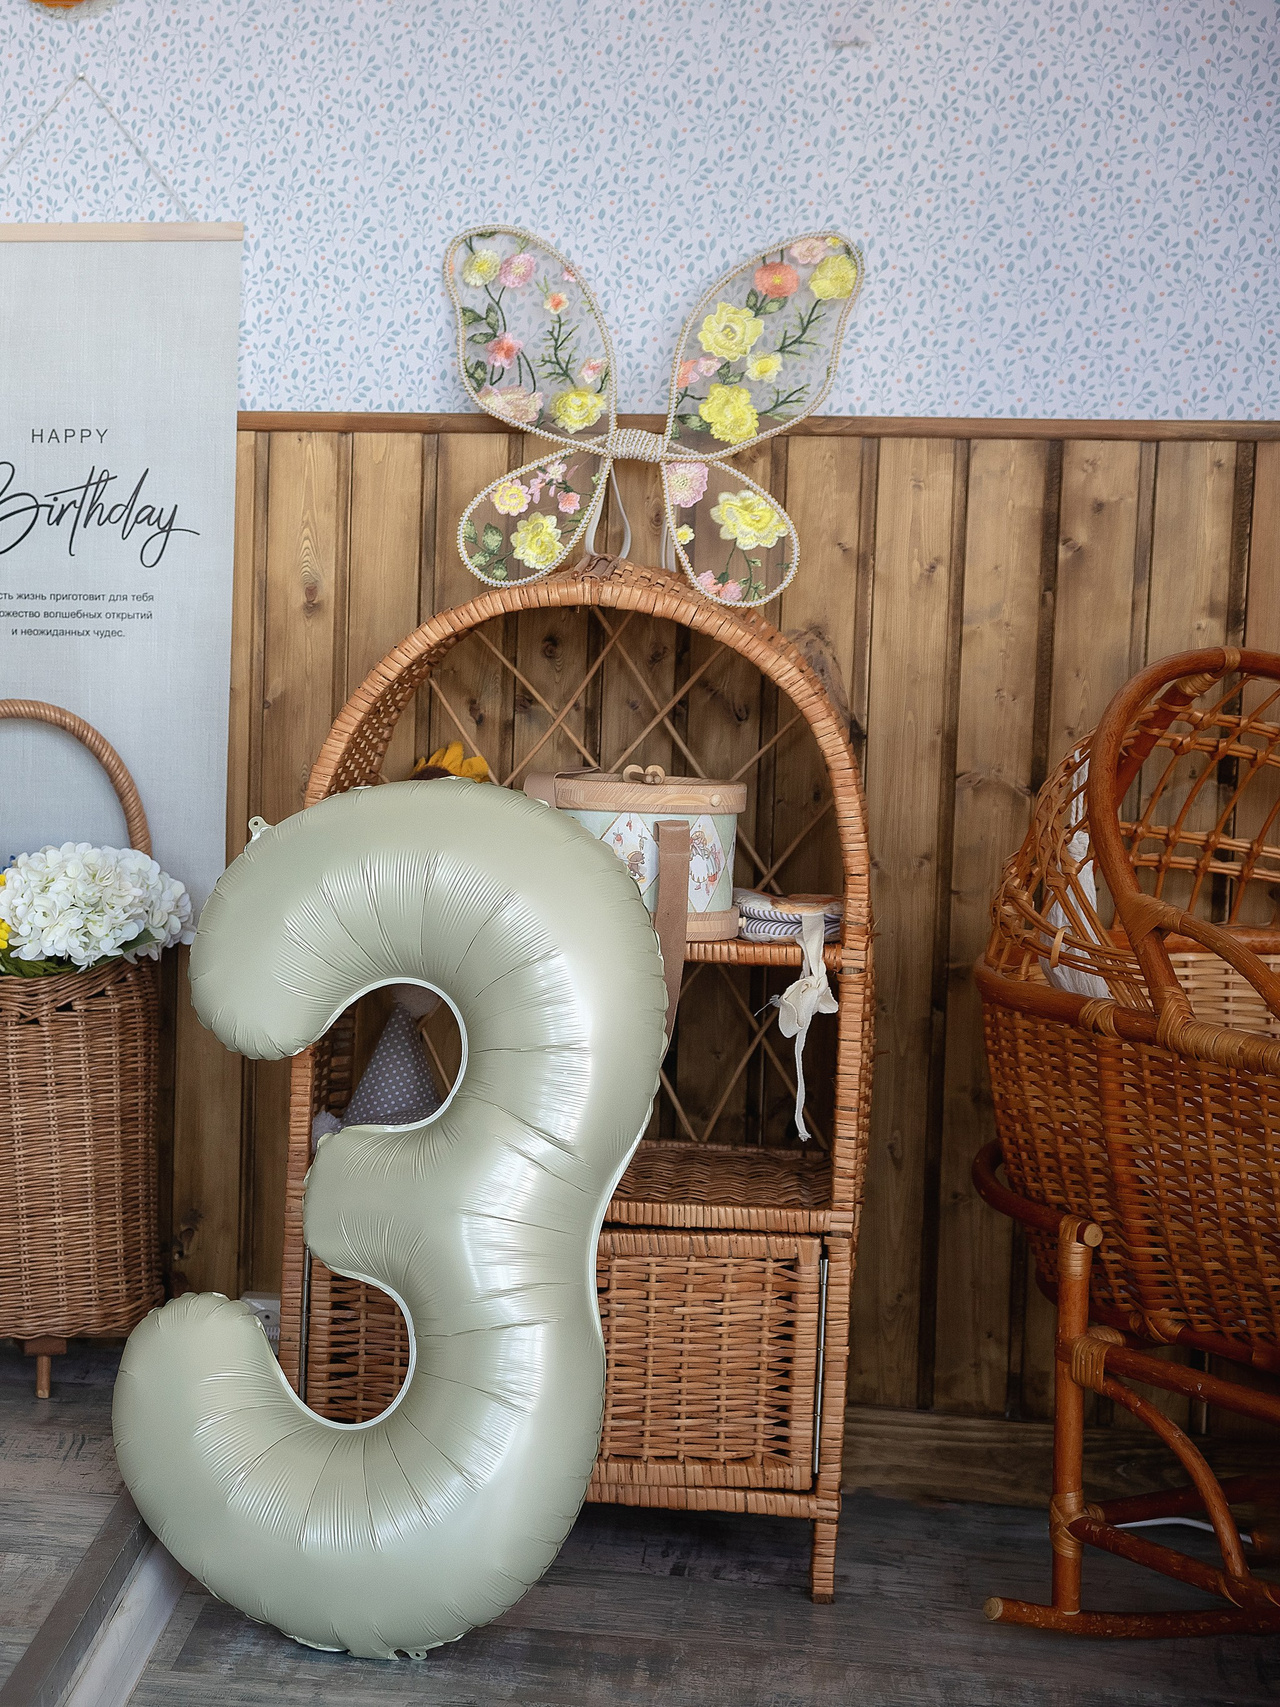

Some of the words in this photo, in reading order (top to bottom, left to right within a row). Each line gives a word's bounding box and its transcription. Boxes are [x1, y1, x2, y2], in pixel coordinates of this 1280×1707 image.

[31, 428, 109, 444] HAPPY
[16, 592, 47, 601] жизнь
[49, 592, 106, 603] приготовит
[108, 593, 128, 603] для
[130, 592, 155, 602] тебя
[43, 609, 102, 620] волшебных
[104, 610, 153, 622] открытий
[11, 628, 18, 636] и
[20, 628, 91, 639] неожиданных
[93, 629, 126, 640] чудес.
[112, 776, 669, 1660] 3
